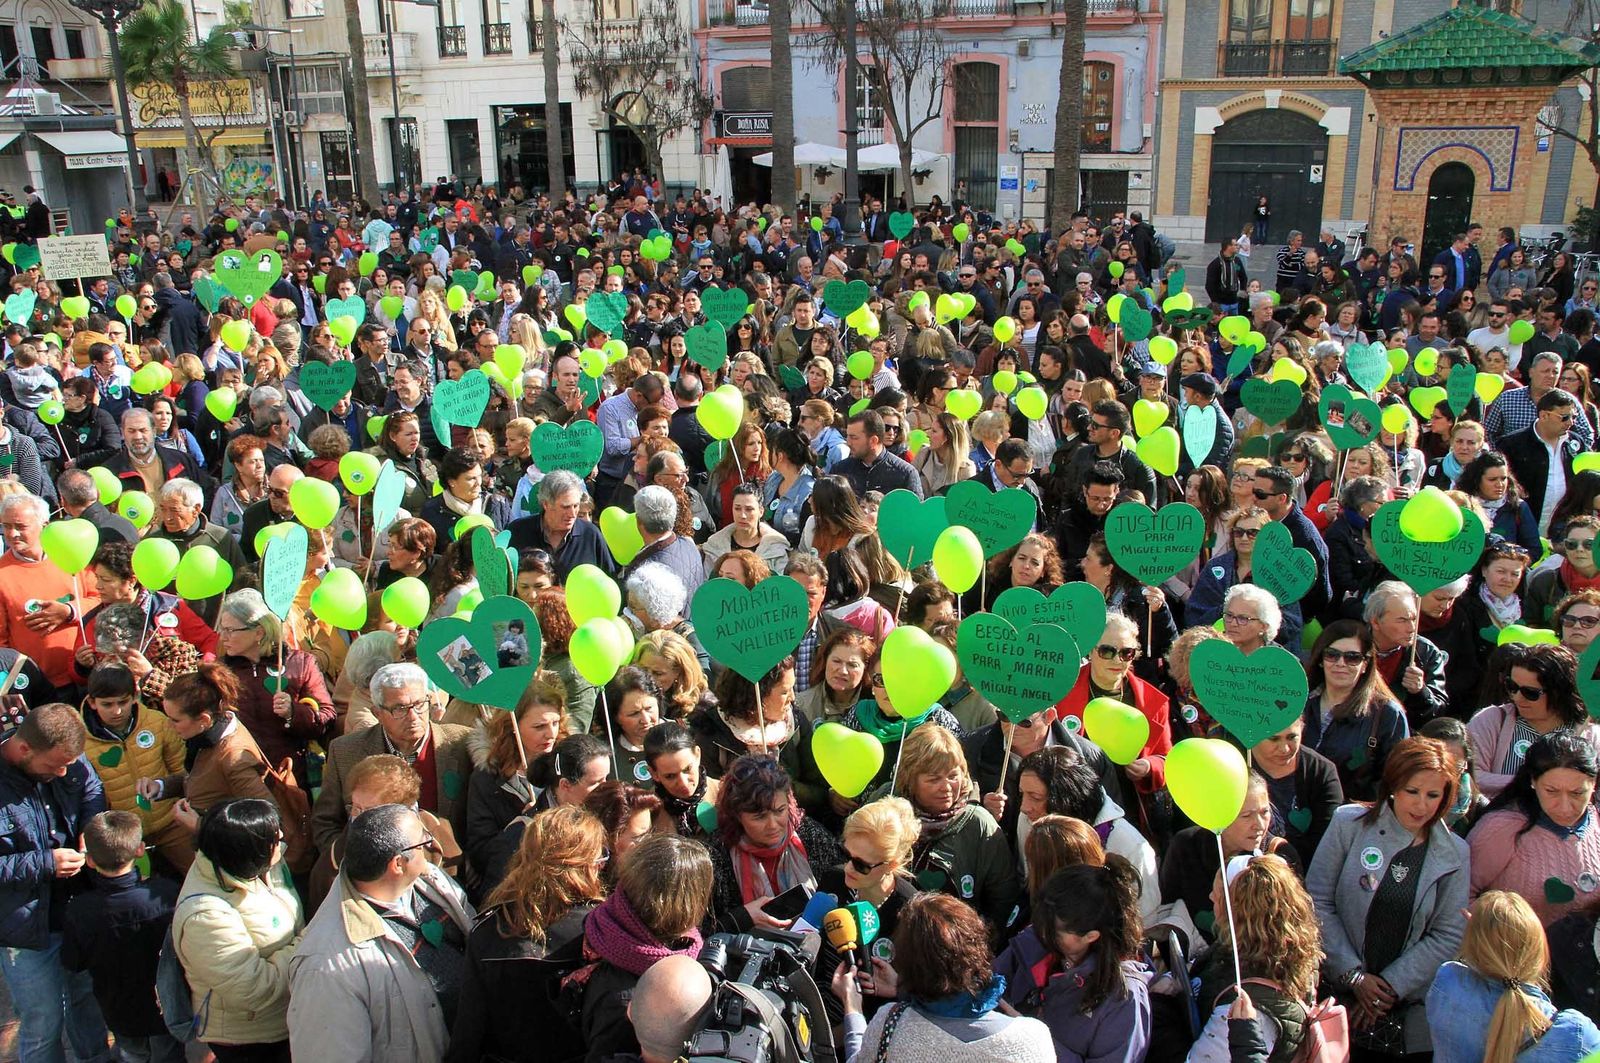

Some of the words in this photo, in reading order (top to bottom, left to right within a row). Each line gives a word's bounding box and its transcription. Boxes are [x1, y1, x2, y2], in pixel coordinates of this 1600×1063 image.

[737, 118, 753, 130] DOÑA
[753, 118, 769, 130] ROSA
[441, 385, 454, 397] TUS
[455, 376, 482, 392] ABUELOS
[442, 402, 452, 411] NO
[452, 396, 460, 405] TE
[963, 496, 978, 511] LA
[1114, 514, 1193, 534] JUSTICIA
[1145, 532, 1175, 542] PARA
[1381, 529, 1406, 544] QUE
[1121, 544, 1160, 556] MIGUEL
[1164, 545, 1196, 553] ANGEL
[1262, 547, 1272, 561] EL
[1266, 530, 1295, 561] MIGUEL
[1293, 556, 1314, 581] ANGEL
[1413, 550, 1434, 564] SOL
[1139, 564, 1175, 576] MARIA
[1273, 559, 1298, 585] MEJOR
[1259, 565, 1290, 602] HERMANO
[716, 604, 798, 641] ALMONTEÑA
[731, 627, 796, 654] VALIENTE
[975, 624, 1017, 642] BESOS
[1026, 632, 1043, 646] AL
[972, 653, 1002, 670] PARA
[987, 642, 1025, 656] CIELO
[1034, 649, 1064, 664] PARA
[1206, 660, 1222, 671] OS
[1269, 667, 1284, 676] DE
[980, 680, 1019, 696] MIGUEL
[1021, 688, 1054, 701] ANGEL
[1216, 702, 1254, 722] JUSTICIA
